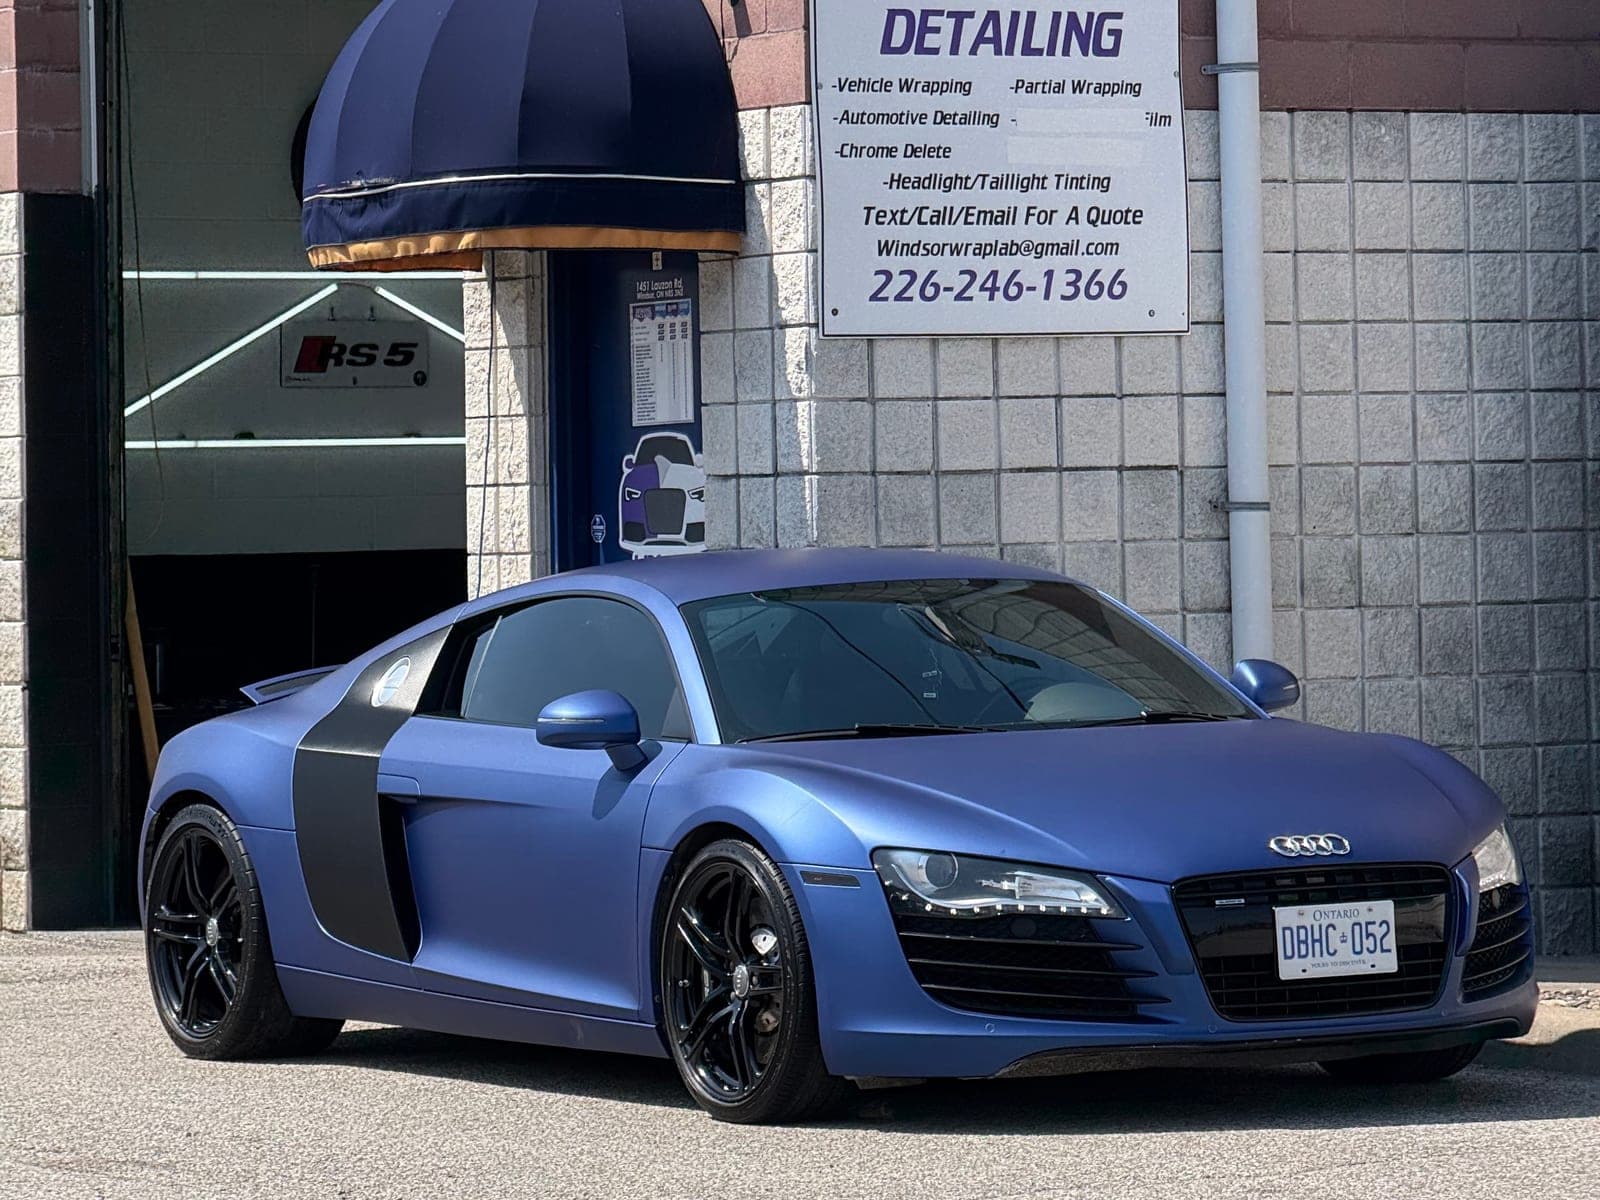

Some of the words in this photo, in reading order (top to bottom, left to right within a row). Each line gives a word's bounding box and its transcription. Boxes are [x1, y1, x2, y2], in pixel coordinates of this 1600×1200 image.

[879, 8, 1124, 57] DETAILING
[898, 78, 972, 96] Wrapping
[1071, 79, 1142, 97] Wrapping
[932, 110, 1000, 128] Detailing
[903, 143, 952, 158] Delete
[1054, 174, 1111, 192] Tinting
[863, 206, 1017, 226] Text/Call/Email
[1024, 206, 1058, 226] For
[1065, 206, 1080, 225] A
[1086, 206, 1144, 227] Quote
[877, 239, 1120, 259] Windsorwraplab@gmail.com
[868, 268, 1128, 302] 226-246-1366
